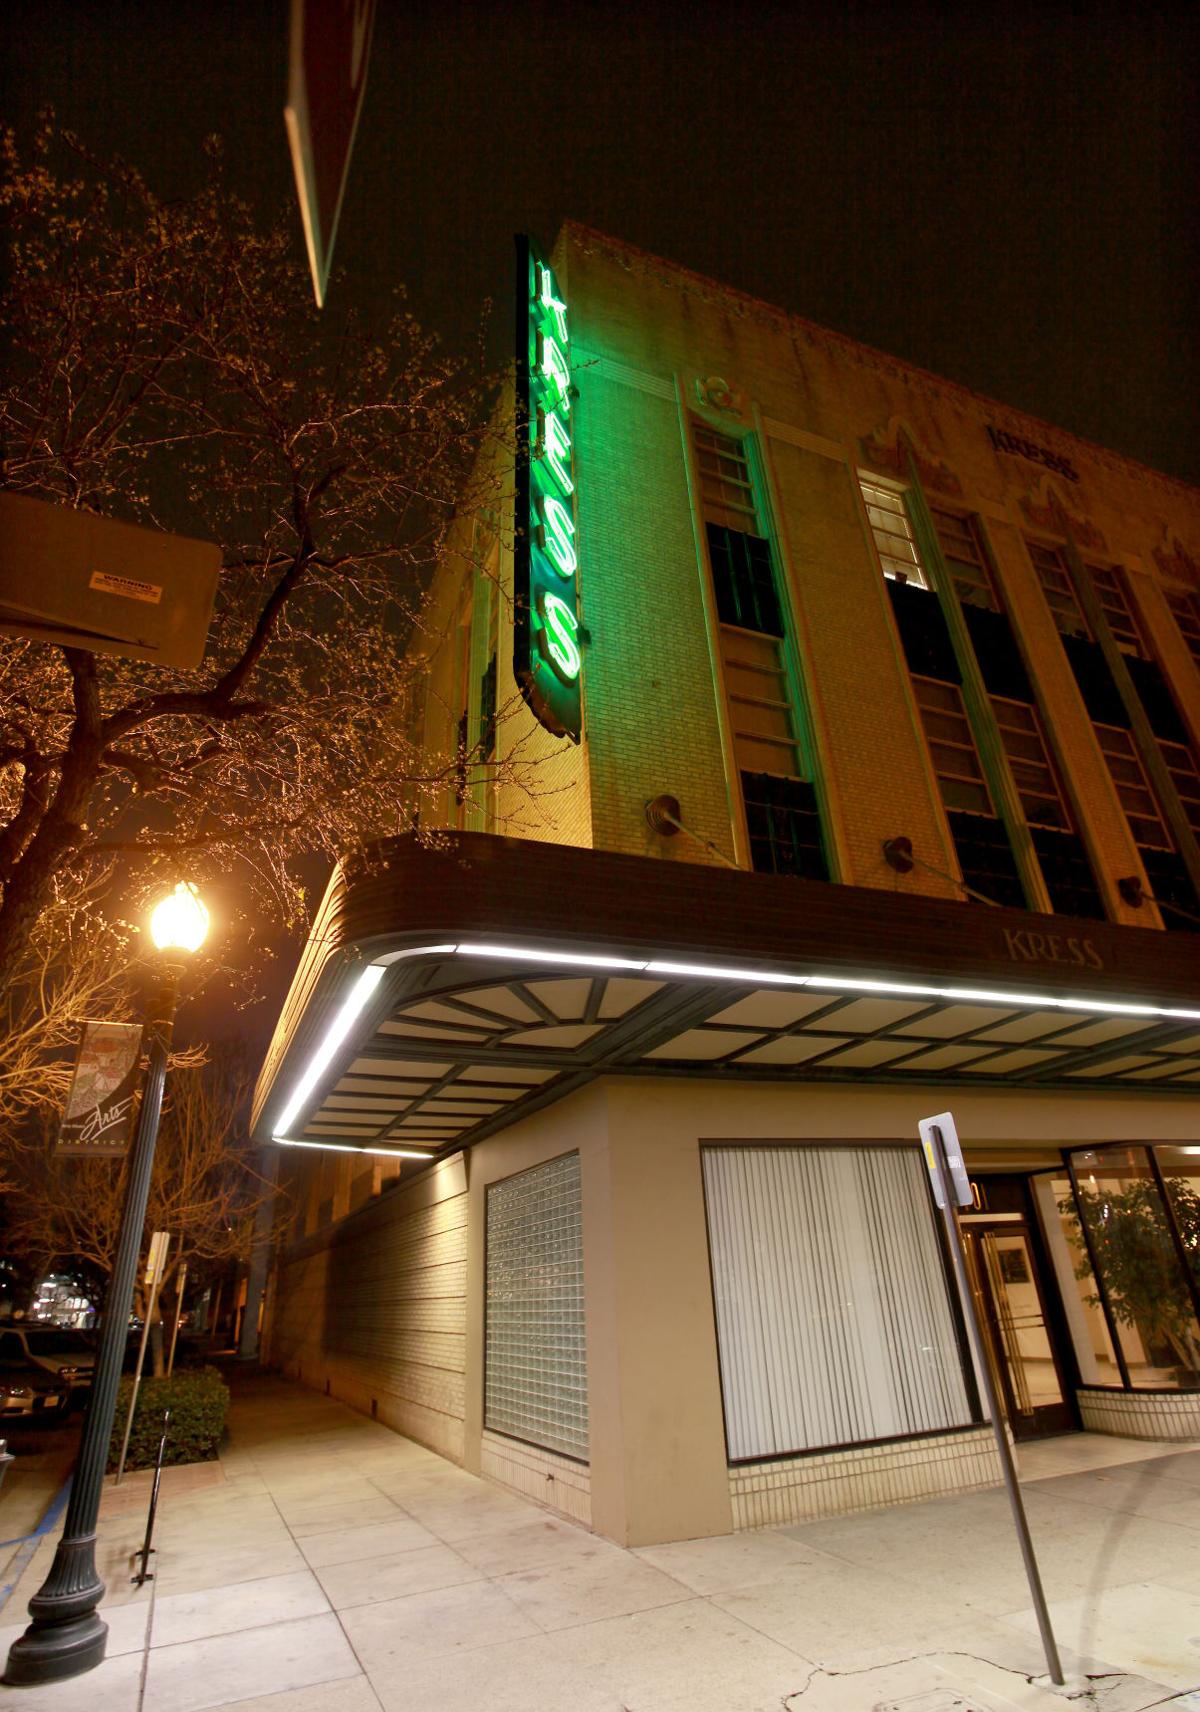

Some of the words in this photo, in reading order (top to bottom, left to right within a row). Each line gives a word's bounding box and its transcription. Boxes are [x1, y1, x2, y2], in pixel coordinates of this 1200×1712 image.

[537, 257, 581, 683] KRESS
[985, 425, 1081, 483] KRESS
[104, 574, 153, 590] WARNING
[1002, 928, 1104, 970] KRESS
[80, 1094, 135, 1141] Arts
